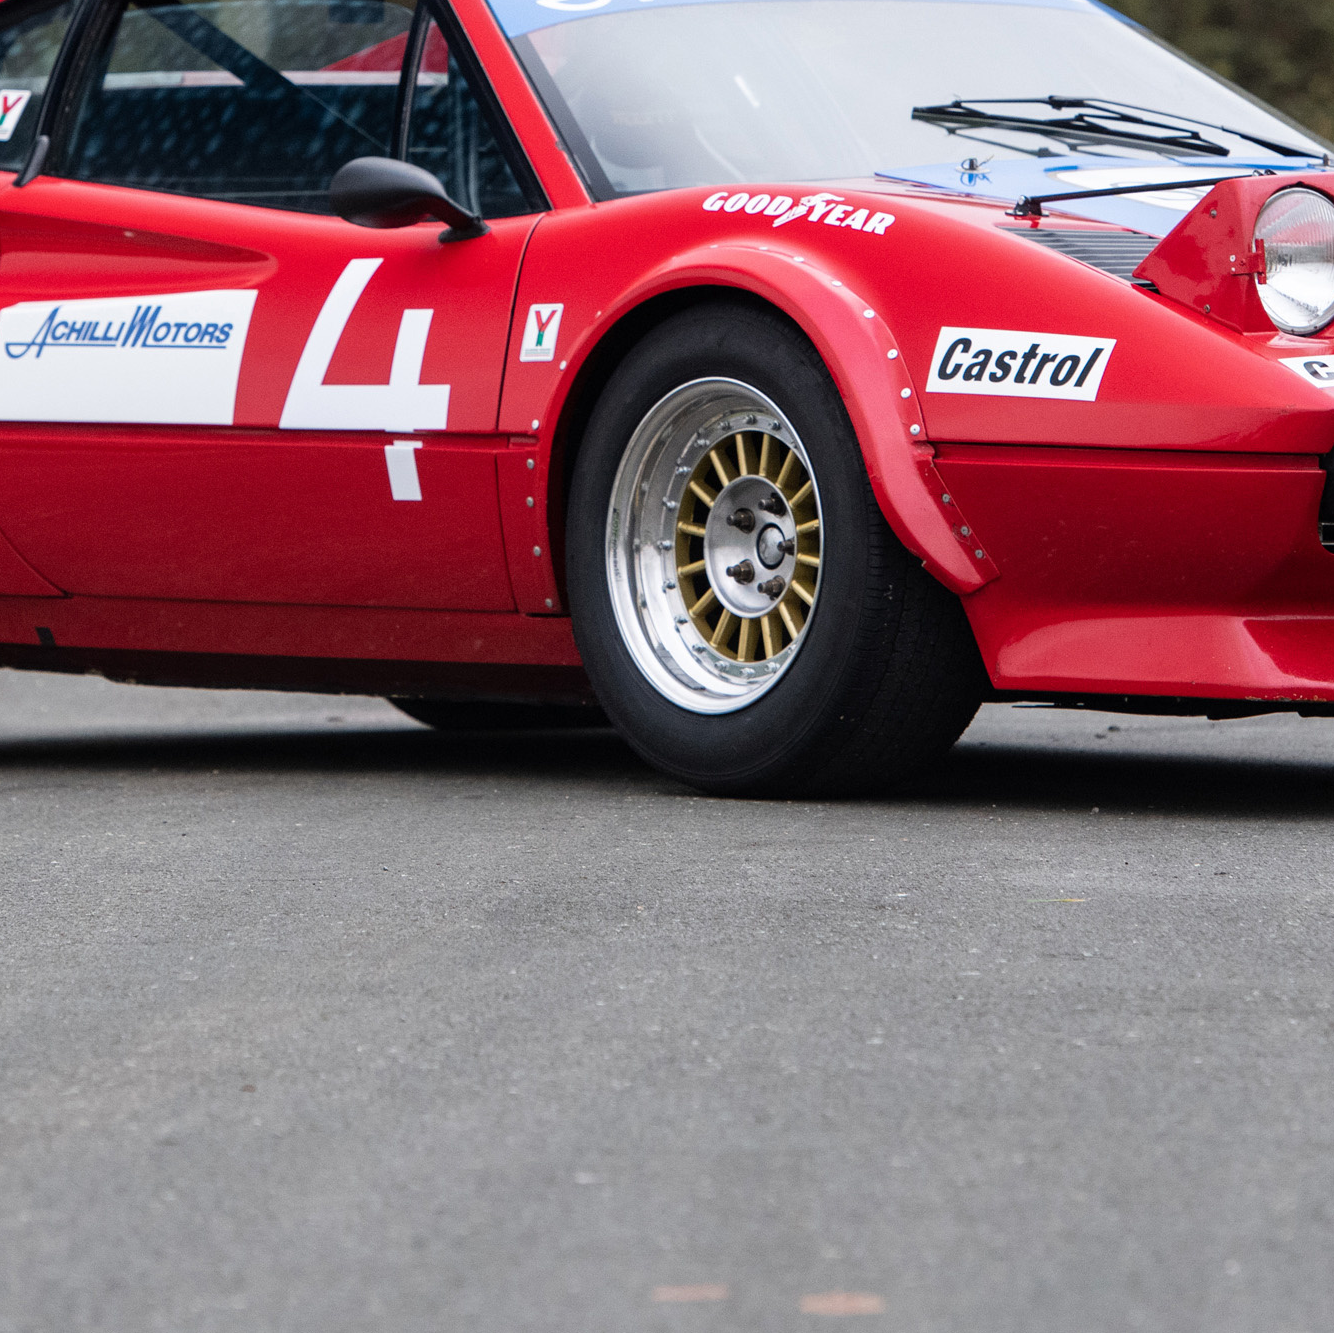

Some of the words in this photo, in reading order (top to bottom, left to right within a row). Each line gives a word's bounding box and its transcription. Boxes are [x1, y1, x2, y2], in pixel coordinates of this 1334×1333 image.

[702, 192, 896, 235] GOODYEAR
[279, 258, 451, 501] 4
[937, 337, 1105, 388] Castrol
